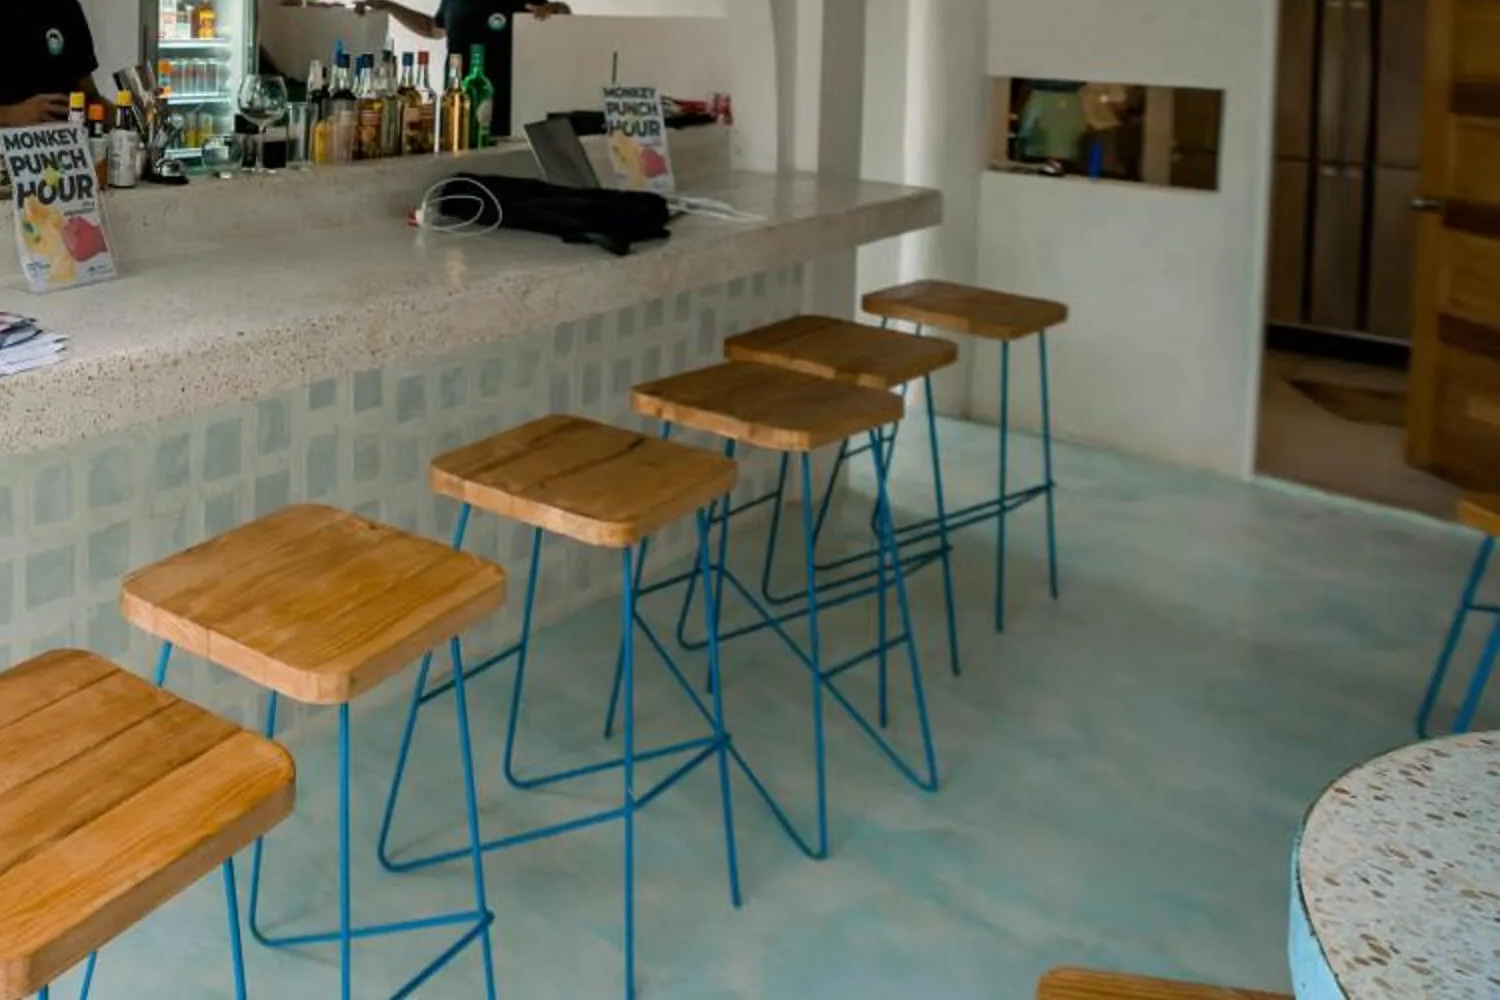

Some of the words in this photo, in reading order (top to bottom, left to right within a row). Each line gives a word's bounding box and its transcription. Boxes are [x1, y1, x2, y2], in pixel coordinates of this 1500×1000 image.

[603, 87, 656, 98] MONKEY
[606, 102, 659, 116] PUNCH
[607, 120, 660, 137] HOUR
[3, 128, 78, 150] MONKEY
[9, 149, 87, 176] PUNCH
[17, 174, 93, 208] HOUR
